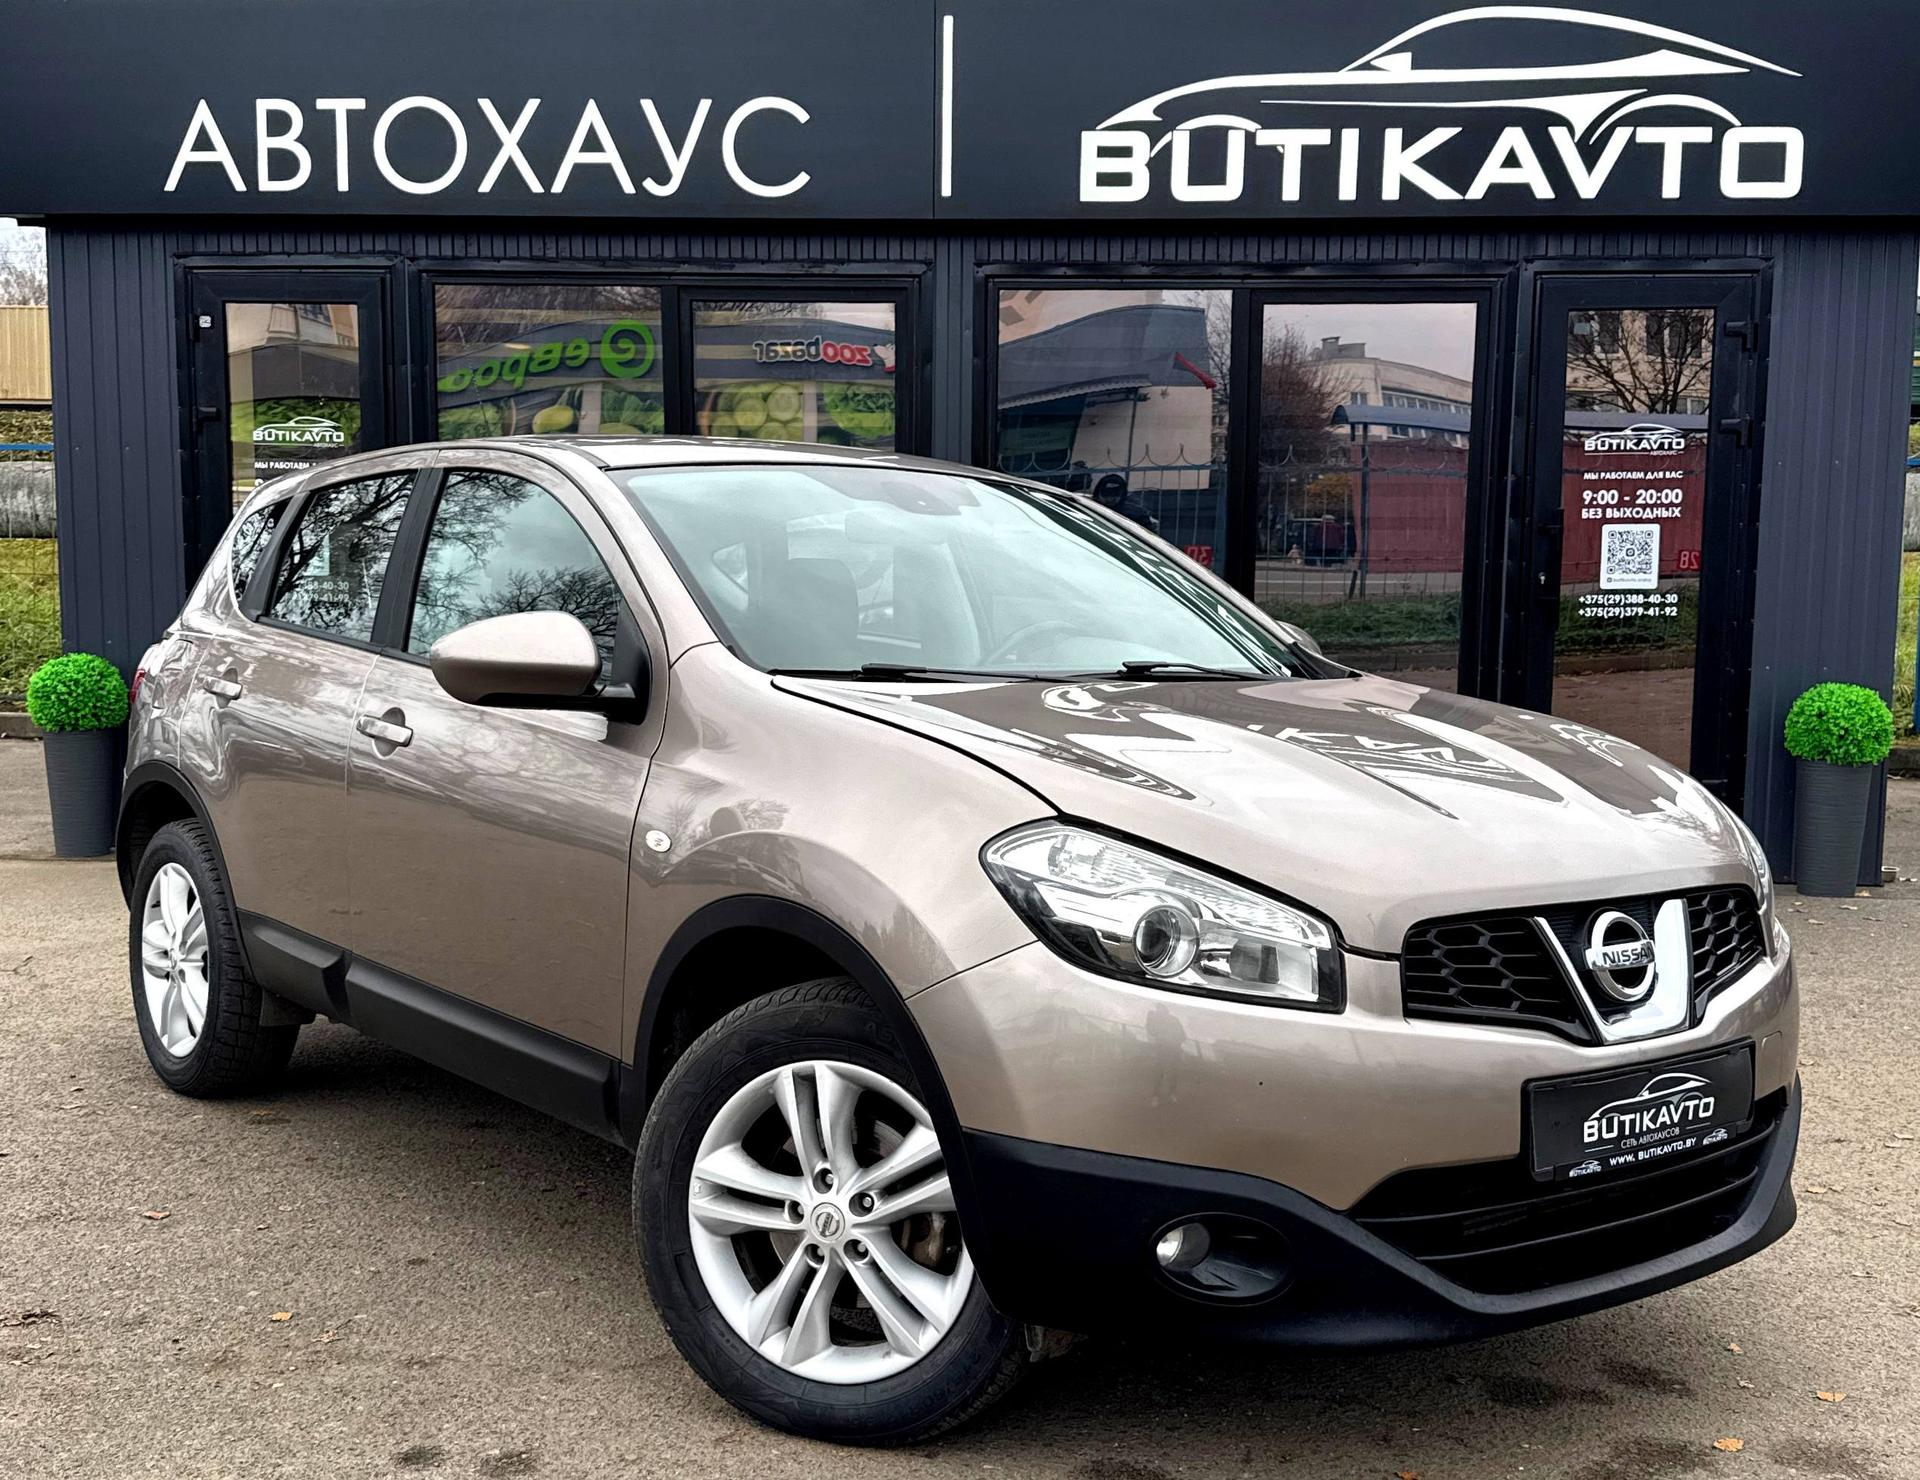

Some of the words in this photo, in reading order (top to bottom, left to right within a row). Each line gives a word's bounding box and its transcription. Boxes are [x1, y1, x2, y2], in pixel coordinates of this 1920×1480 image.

[163, 96, 811, 197] АВТОХАУС
[1080, 125, 1803, 202] BUTIKAVTO
[253, 429, 344, 442] BUTIKAVTO
[1584, 437, 1685, 451] BUTIKAVTO
[1584, 472, 1599, 480] МЫ
[1600, 471, 1644, 480] РАБОТАЕМ
[1645, 471, 1664, 480] ДЛЯ
[1665, 470, 1683, 479] ВАС
[1582, 489, 1619, 505] 9:00
[1635, 488, 1683, 505] 20:00
[1581, 508, 1603, 519] БЕЗ
[1606, 506, 1681, 519] ВЫХОДНЫХ
[1579, 594, 1678, 605] +375(29)388-40-30
[1578, 606, 1678, 618] +375(29)379-41-92
[1583, 1096, 1715, 1143] BUTIKAVTO
[1620, 1138, 1638, 1149] СЕТЬ
[1638, 1137, 1697, 1161] BUTIKAVTO.BY
